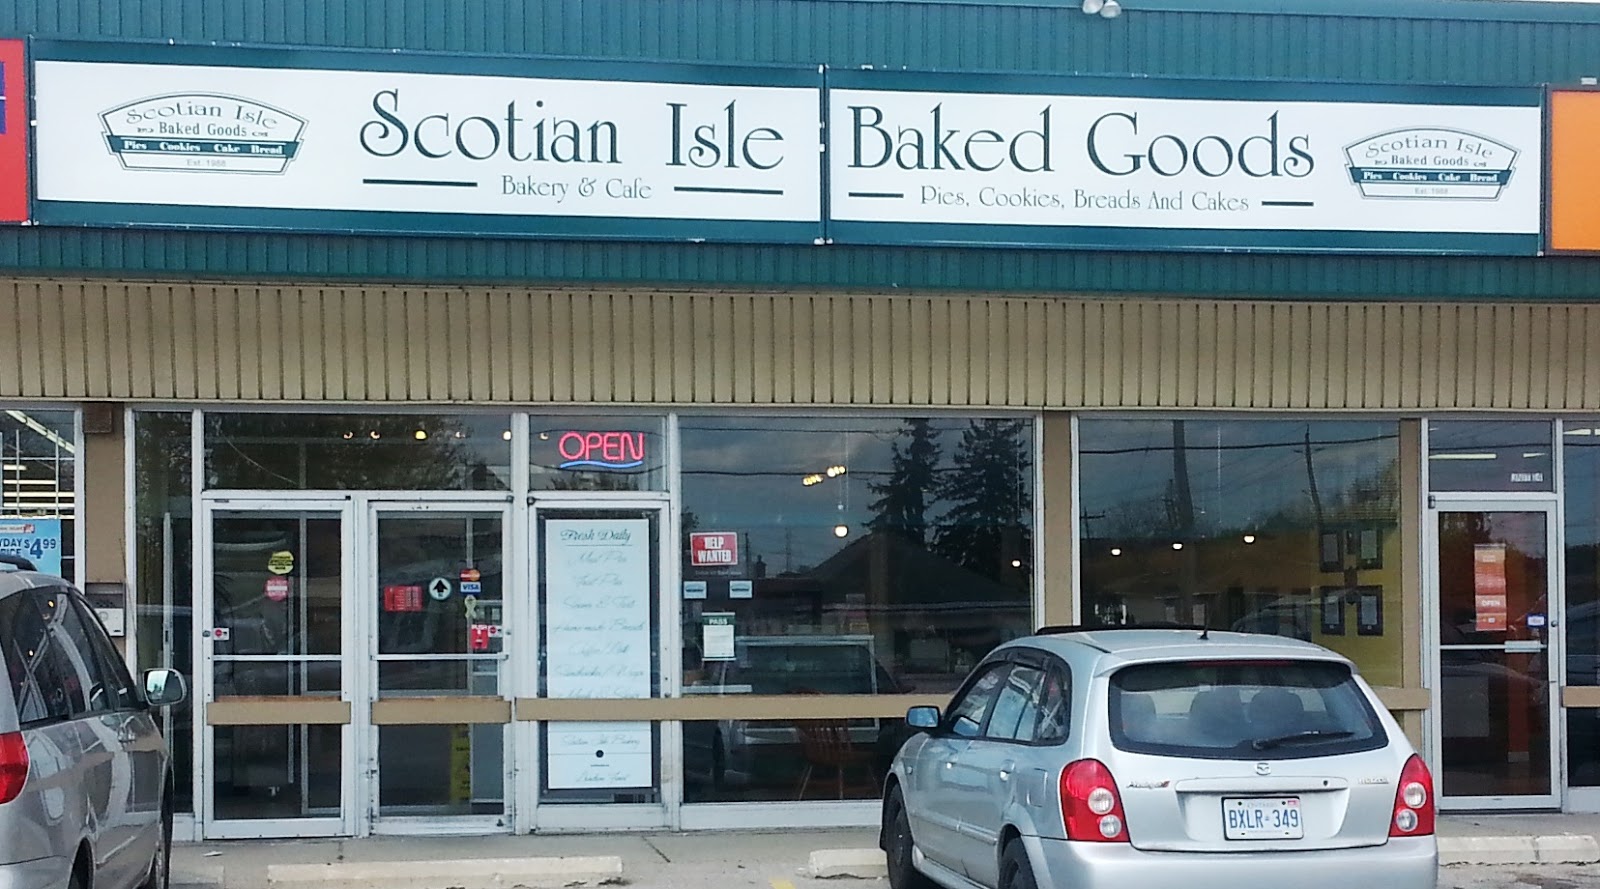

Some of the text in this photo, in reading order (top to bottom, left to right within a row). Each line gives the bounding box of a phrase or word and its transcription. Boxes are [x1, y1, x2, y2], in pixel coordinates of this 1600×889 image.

[125, 101, 278, 129] Scotian Isle
[158, 121, 248, 137] Baked Goods
[358, 86, 785, 170] Scotian Isle
[123, 140, 283, 154] Pies Cookies Cake Bread
[845, 101, 1316, 178] Baked Goods
[1365, 134, 1493, 159] Scotian Isle
[1391, 155, 1470, 167] Baked Goods
[1363, 171, 1498, 182] Pies Cookies Cake Bread
[501, 175, 652, 203] Bakery & Cafe
[920, 185, 1250, 212] Pies, Cookies, Breads And Cakes
[558, 431, 645, 461] OPEN
[560, 528, 632, 545] Fresh Daily
[704, 536, 725, 549] HELP
[697, 550, 732, 563] WANTED
[1229, 809, 1299, 829] BXLR 349
